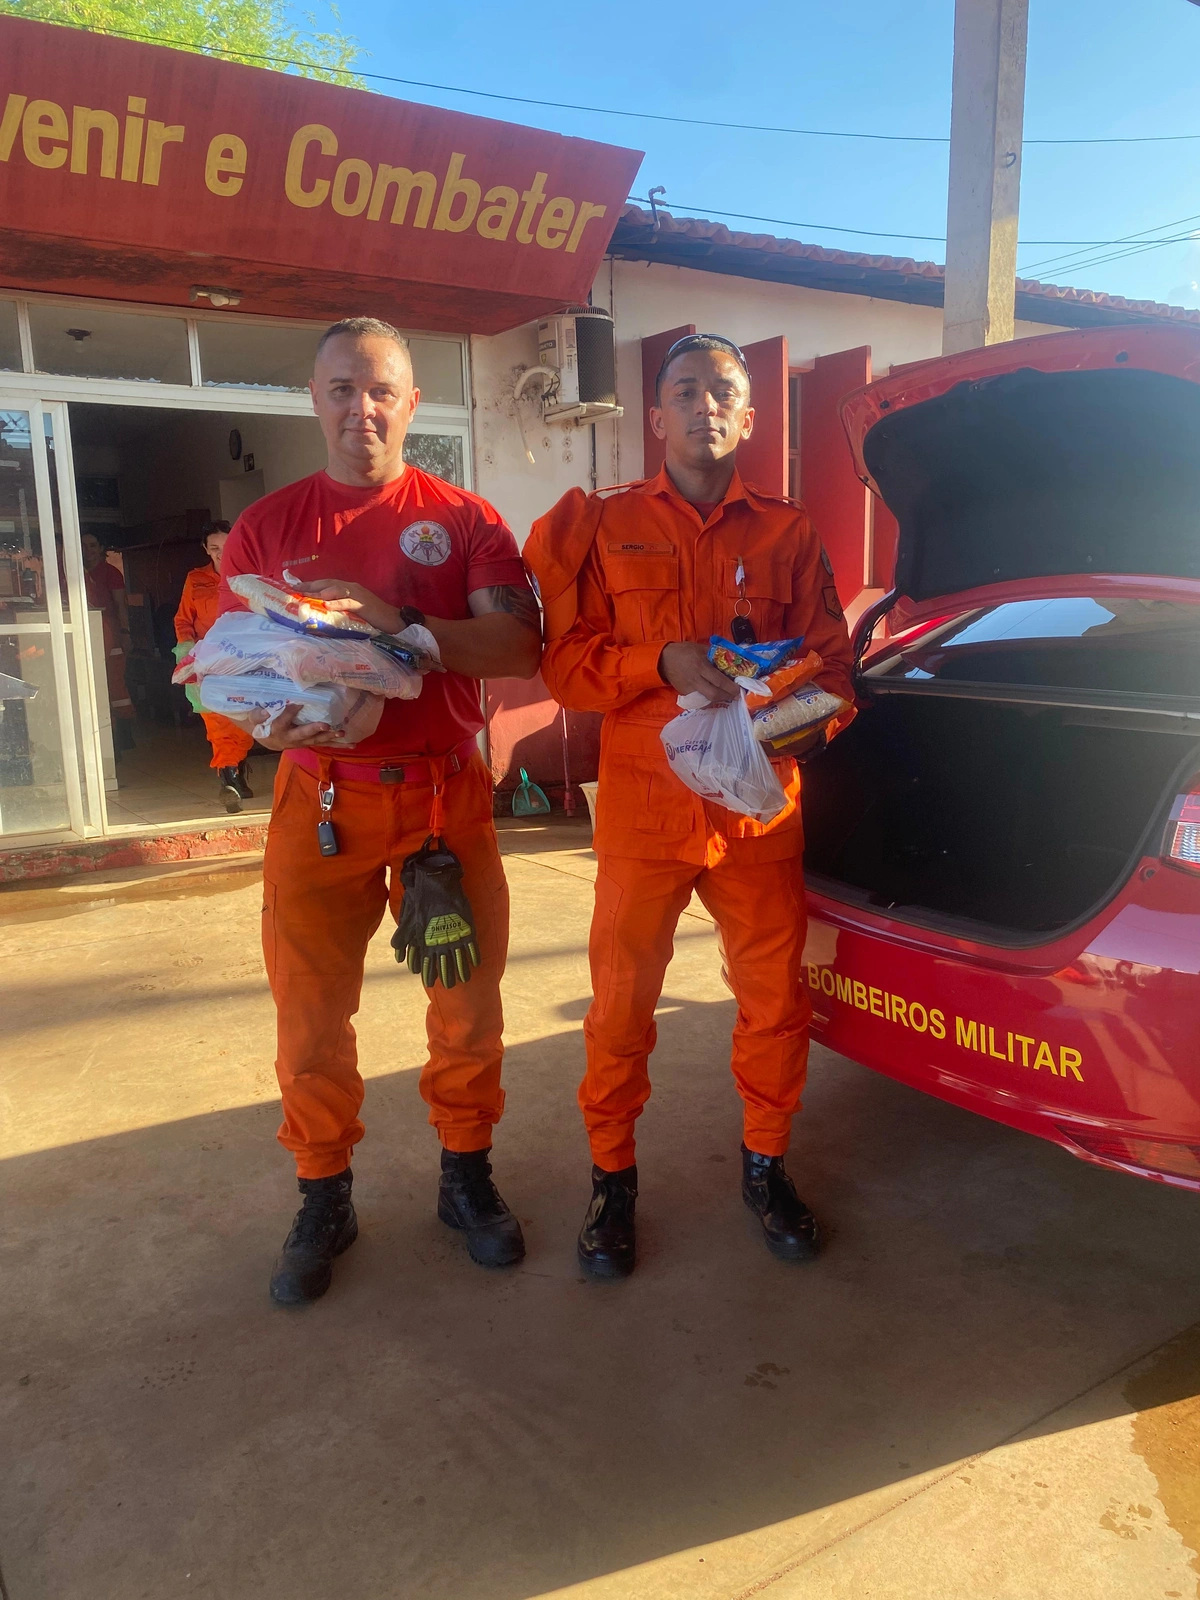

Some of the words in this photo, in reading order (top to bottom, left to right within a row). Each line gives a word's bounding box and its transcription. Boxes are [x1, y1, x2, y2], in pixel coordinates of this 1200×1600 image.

[204, 133, 248, 197] e
[284, 123, 607, 253] Combater
[431, 921, 462, 932] ROSTAING
[807, 961, 946, 1039] BOMBEIROS
[955, 1015, 1085, 1083] MILITAR
